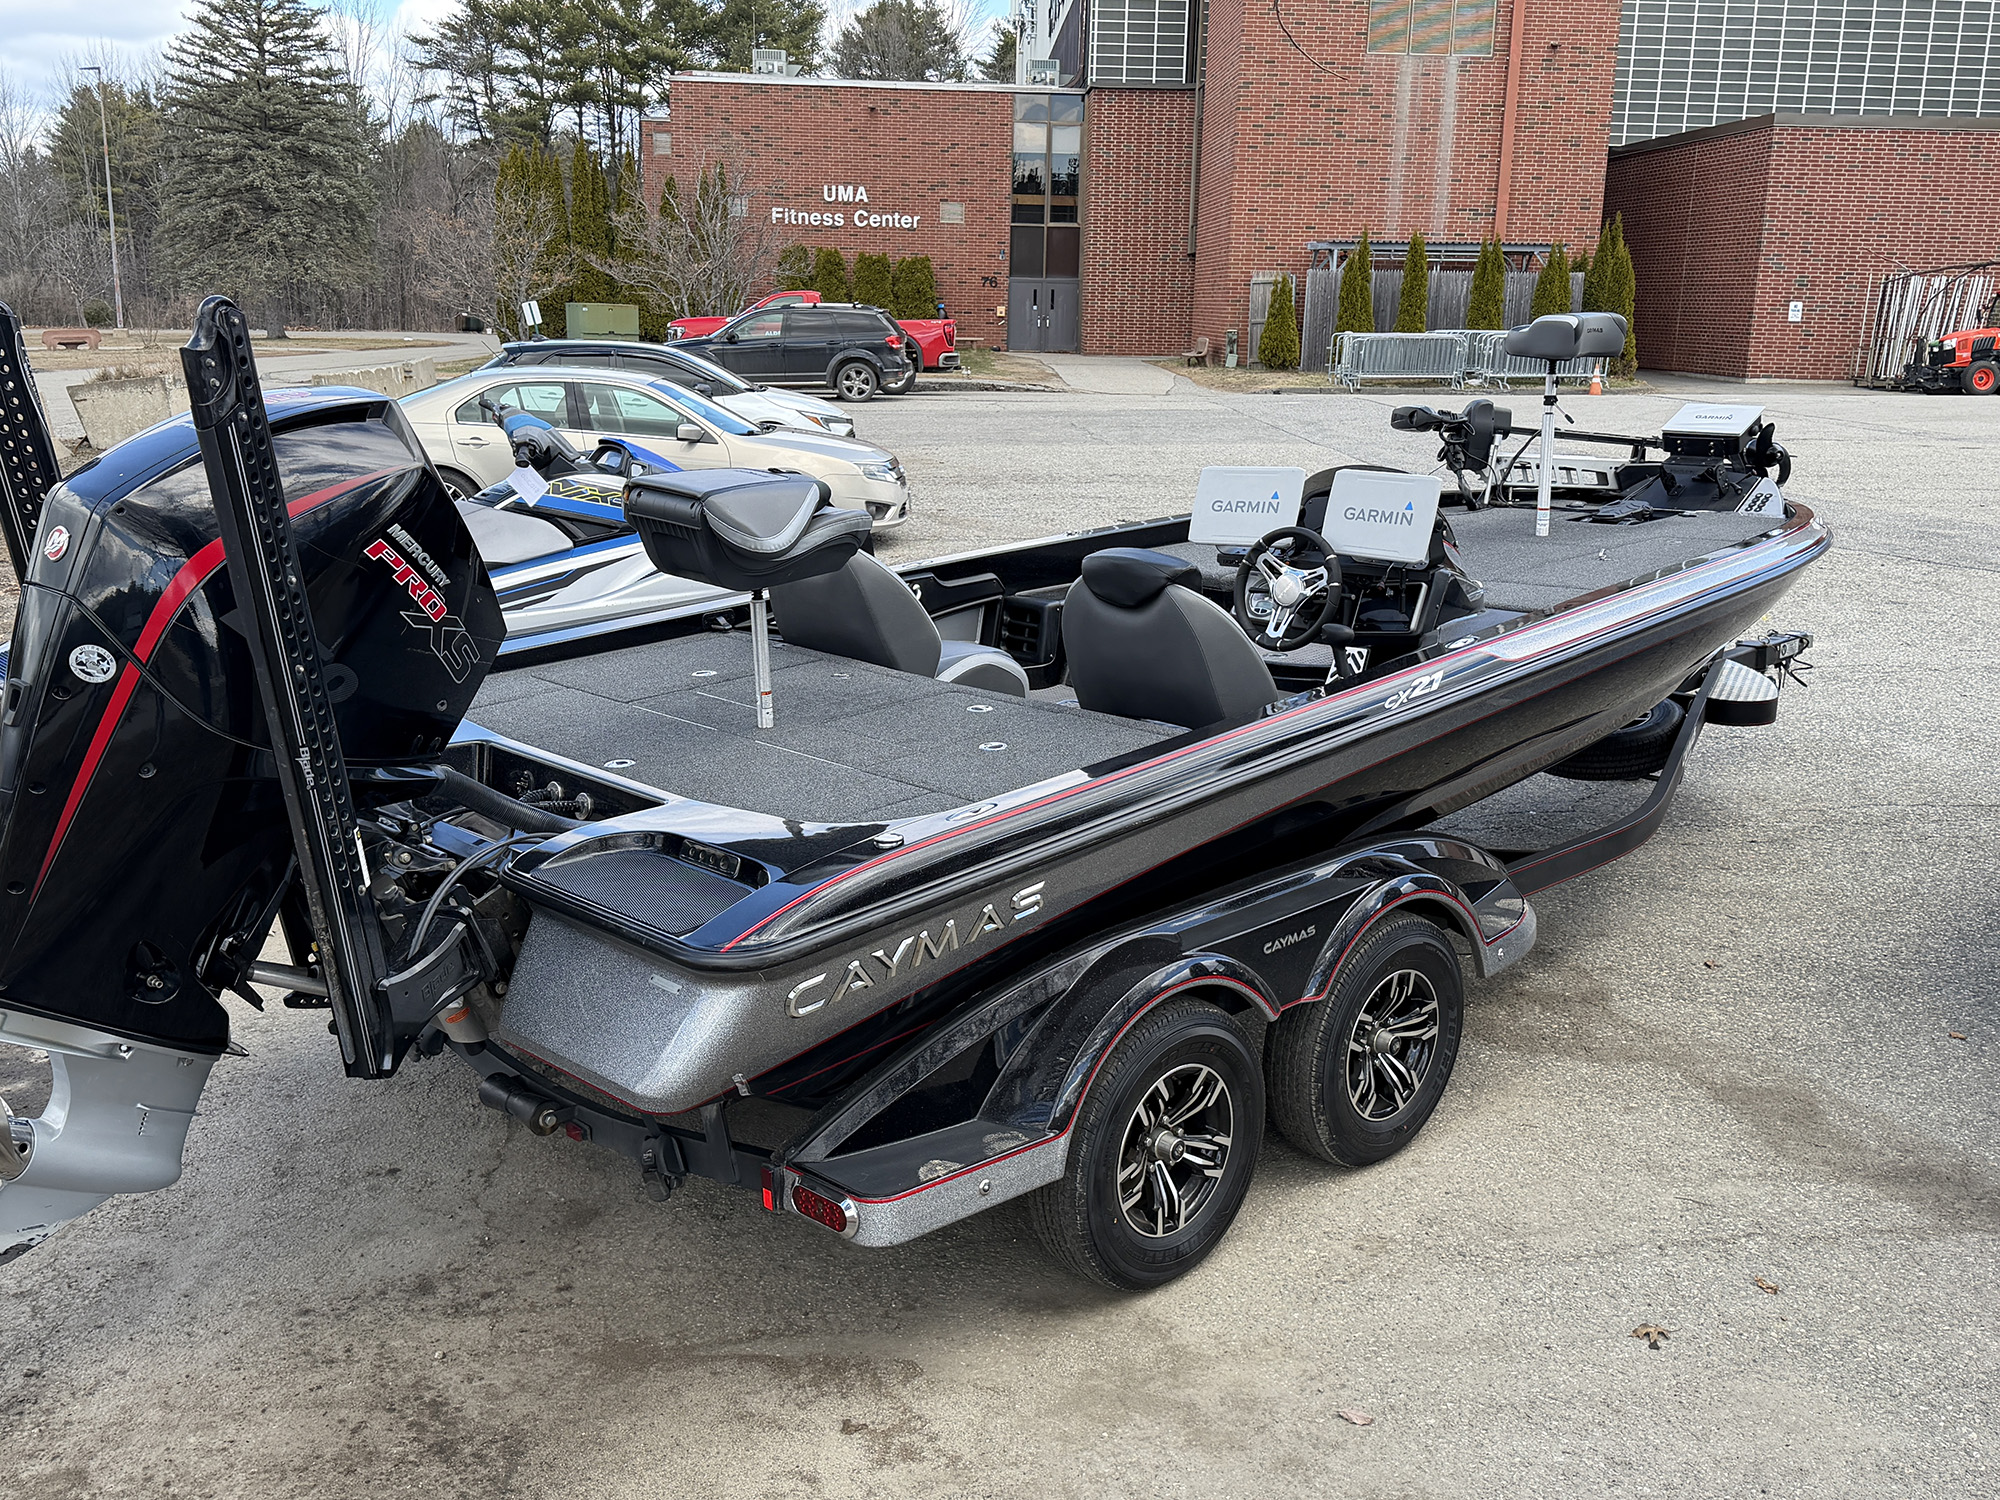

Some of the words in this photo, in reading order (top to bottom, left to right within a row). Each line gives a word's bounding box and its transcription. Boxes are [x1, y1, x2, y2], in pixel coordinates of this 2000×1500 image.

[823, 185, 868, 203] UMA
[771, 207, 845, 228] Fitness
[853, 209, 921, 229] Center
[981, 276, 999, 288] 76
[1211, 500, 1280, 514] GARMIN
[1343, 507, 1414, 526] GARMIN
[387, 523, 451, 588] MERCURY
[363, 538, 448, 623] PRO
[400, 611, 481, 684] XS
[295, 746, 315, 788] Blade
[784, 880, 1046, 1019] CAYMAS
[1263, 925, 1317, 955] CAYMAS
